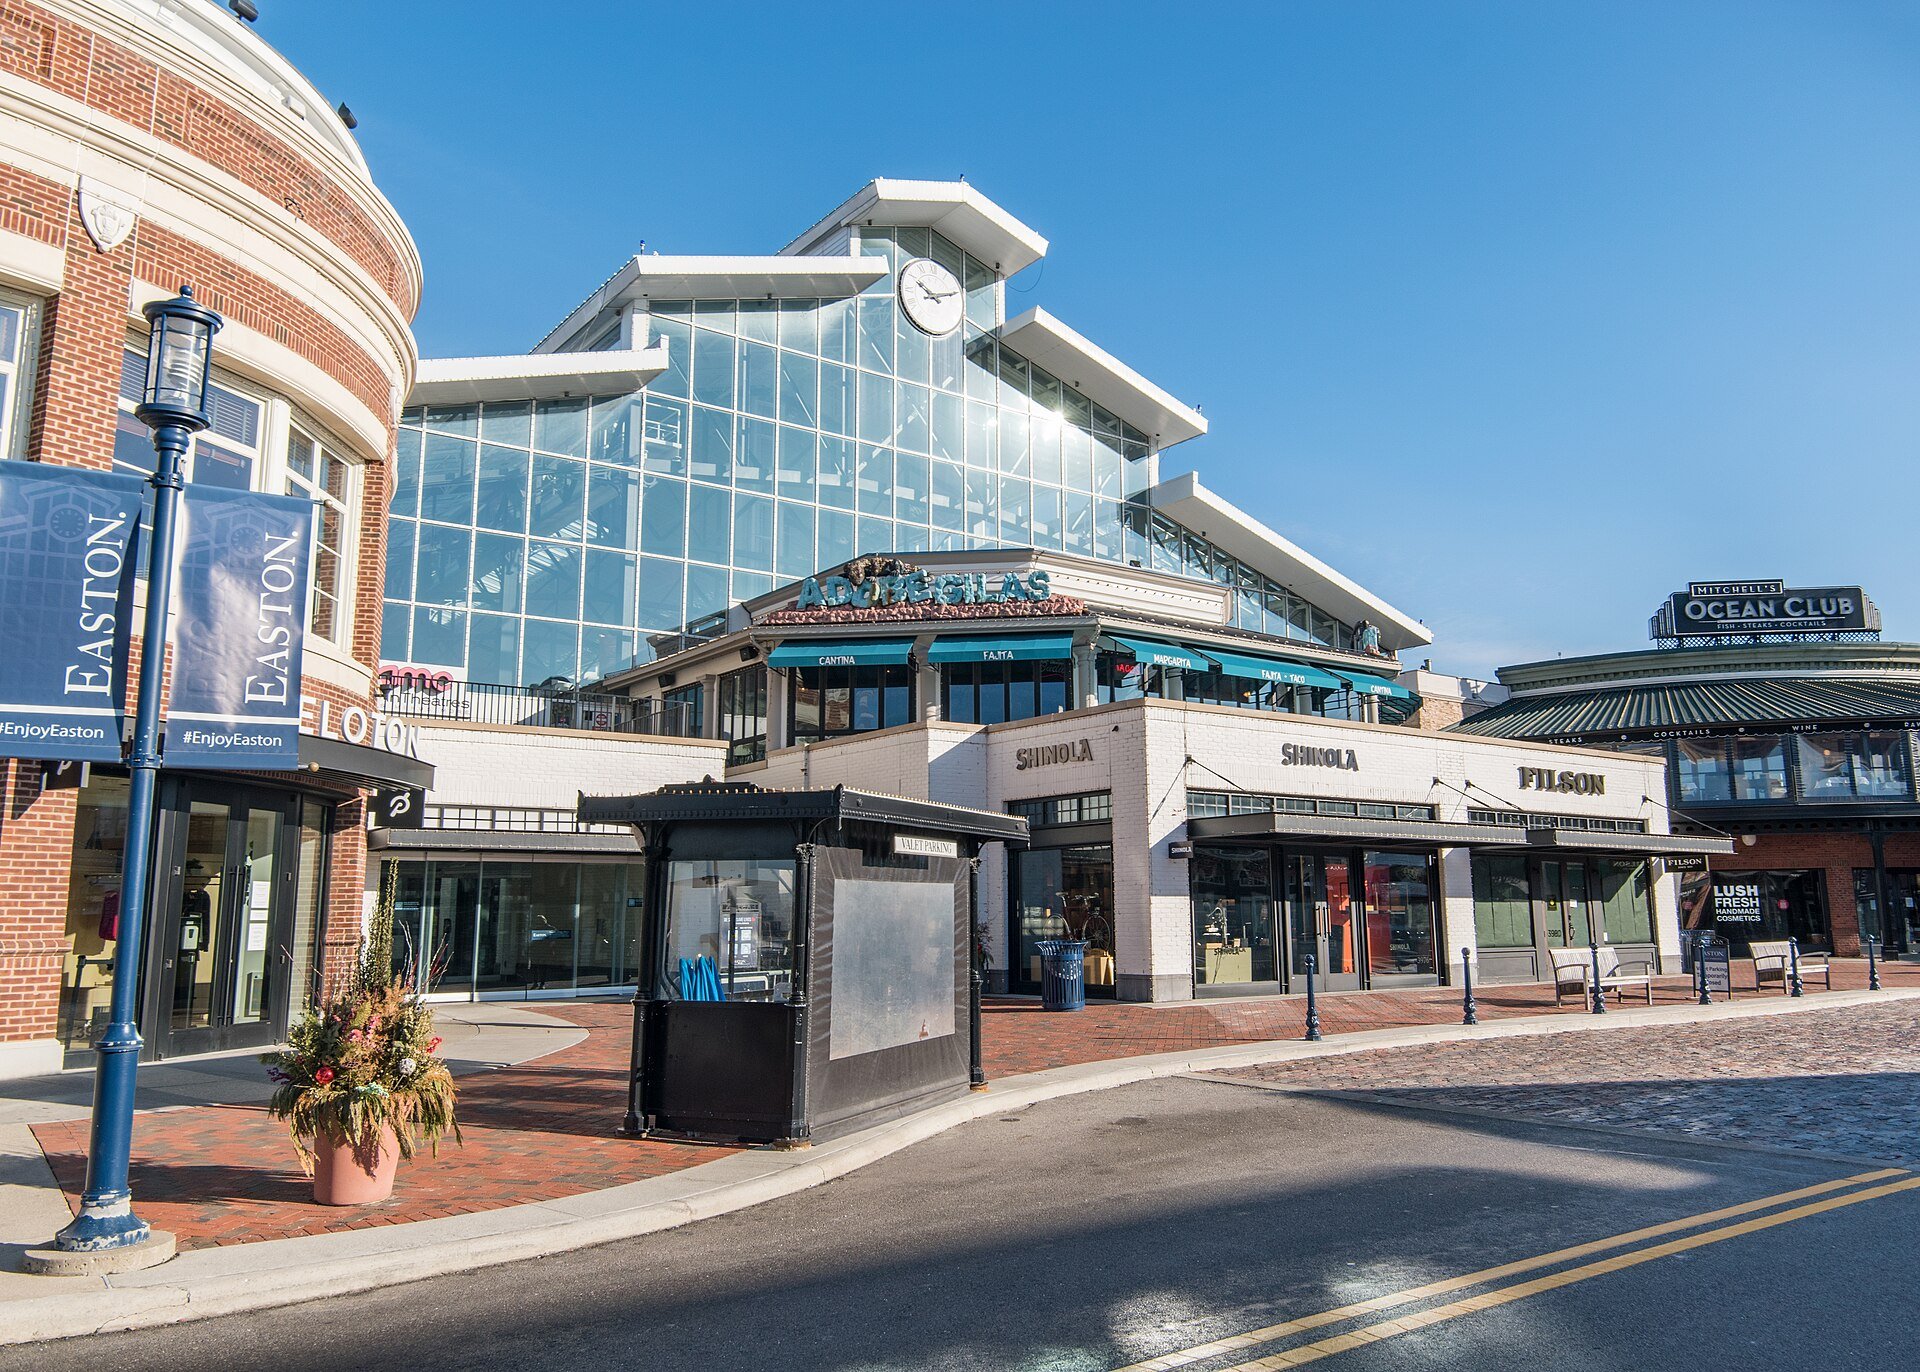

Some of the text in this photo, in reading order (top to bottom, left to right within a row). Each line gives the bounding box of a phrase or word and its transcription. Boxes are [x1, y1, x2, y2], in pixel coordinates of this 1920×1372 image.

[1697, 584, 1776, 595] MITCHELL'S
[1685, 597, 1855, 620] OCEAN CLUB
[1780, 620, 1827, 628] COCKTAILS
[819, 656, 855, 666] CANTINA
[983, 650, 1014, 661] FAJITA
[1153, 653, 1191, 668] MARGARITA
[1261, 669, 1306, 684] FAJITA TACO
[300, 694, 420, 760] ELOTON
[1653, 728, 1711, 738] COCKTAILS
[183, 731, 282, 747] #EnjoyEaston
[1016, 738, 1093, 770] SHINOLA
[1281, 742, 1359, 772] SHINOLA
[1517, 766, 1605, 796] FILSON
[901, 837, 952, 854] VALET PARKING
[1171, 846, 1192, 854] SHINOLA
[1668, 858, 1702, 866] FILSON
[1713, 884, 1759, 897] LUSH
[1714, 897, 1760, 908] FRESH
[1547, 929, 1562, 938] 3980
